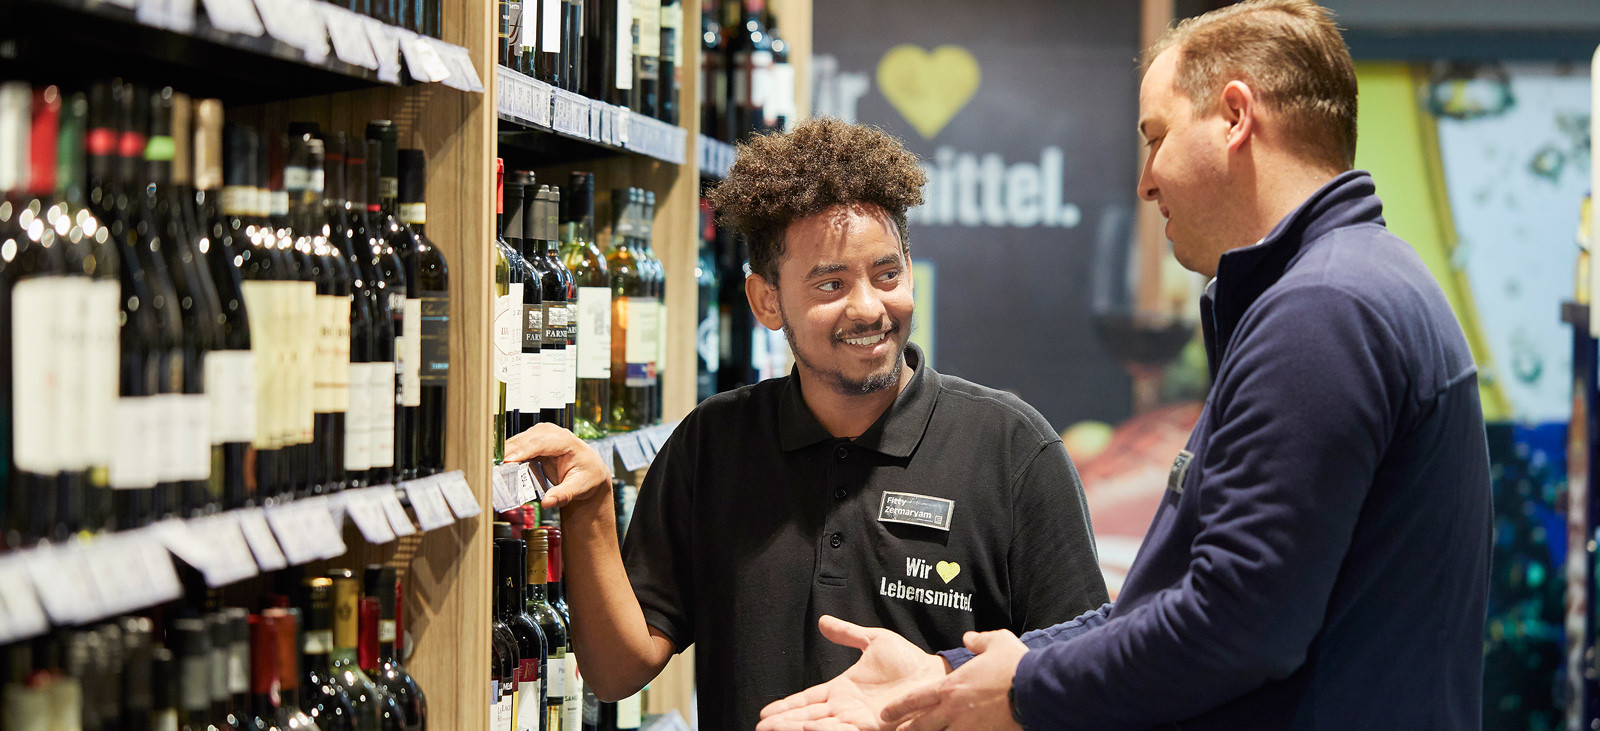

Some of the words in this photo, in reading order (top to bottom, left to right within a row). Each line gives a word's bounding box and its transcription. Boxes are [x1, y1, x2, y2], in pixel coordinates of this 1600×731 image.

[810, 54, 871, 125] ir
[906, 557, 933, 579] Wir
[880, 576, 973, 612] Lebensmittel.
